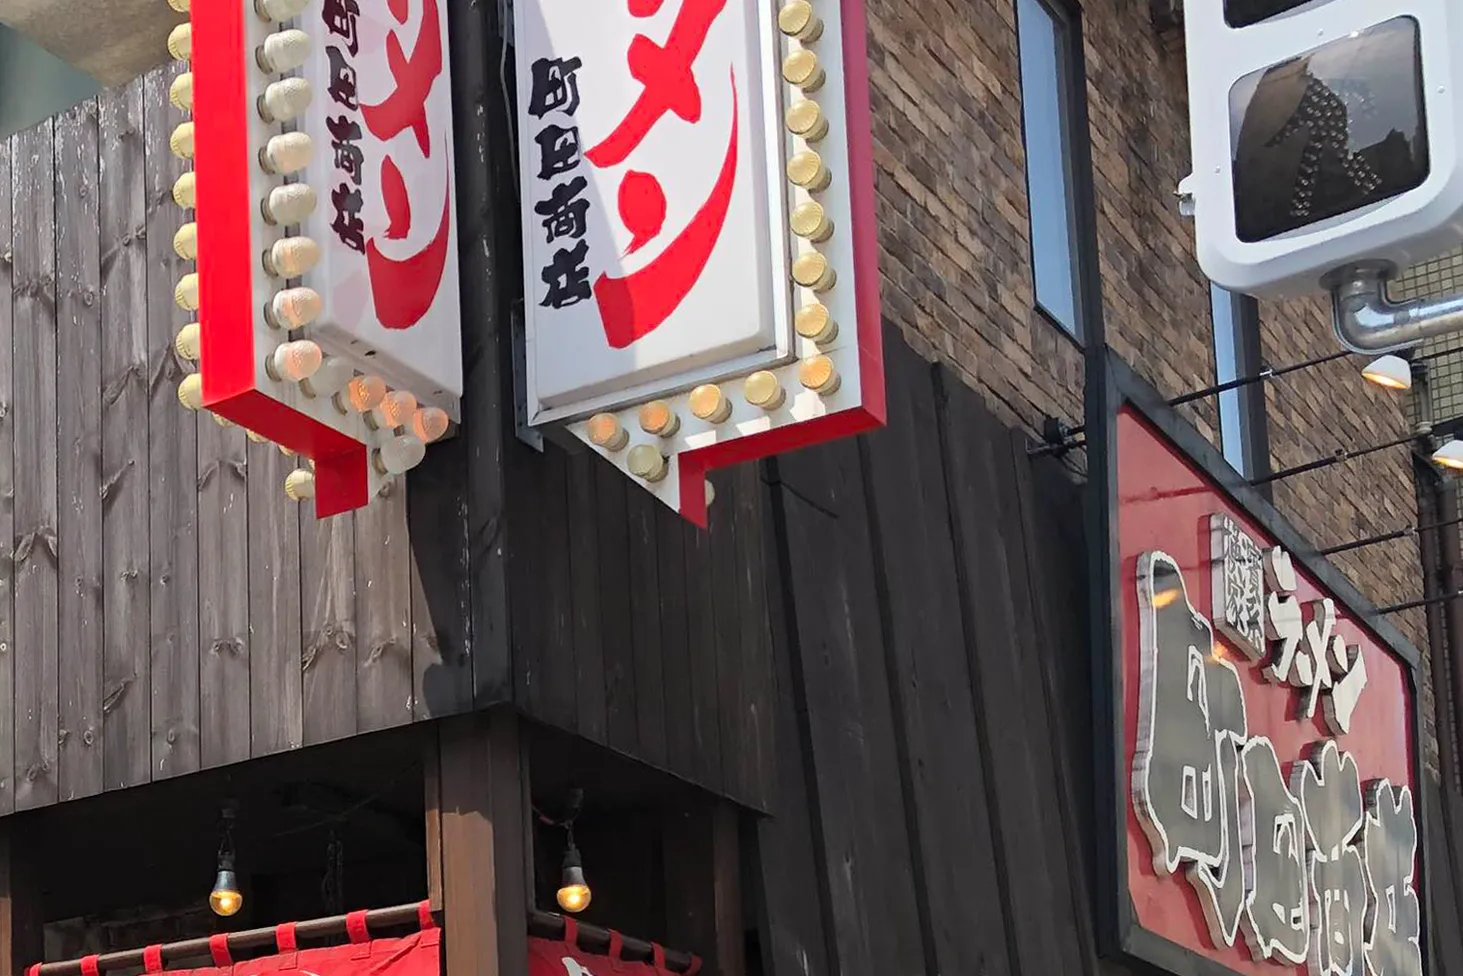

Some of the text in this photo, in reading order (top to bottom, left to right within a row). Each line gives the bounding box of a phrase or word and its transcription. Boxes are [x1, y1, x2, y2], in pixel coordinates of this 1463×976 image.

[358, 0, 449, 329] メン
[528, 56, 592, 310] 町田商店
[584, 0, 739, 349] メン
[1261, 546, 1368, 735] ラーメン
